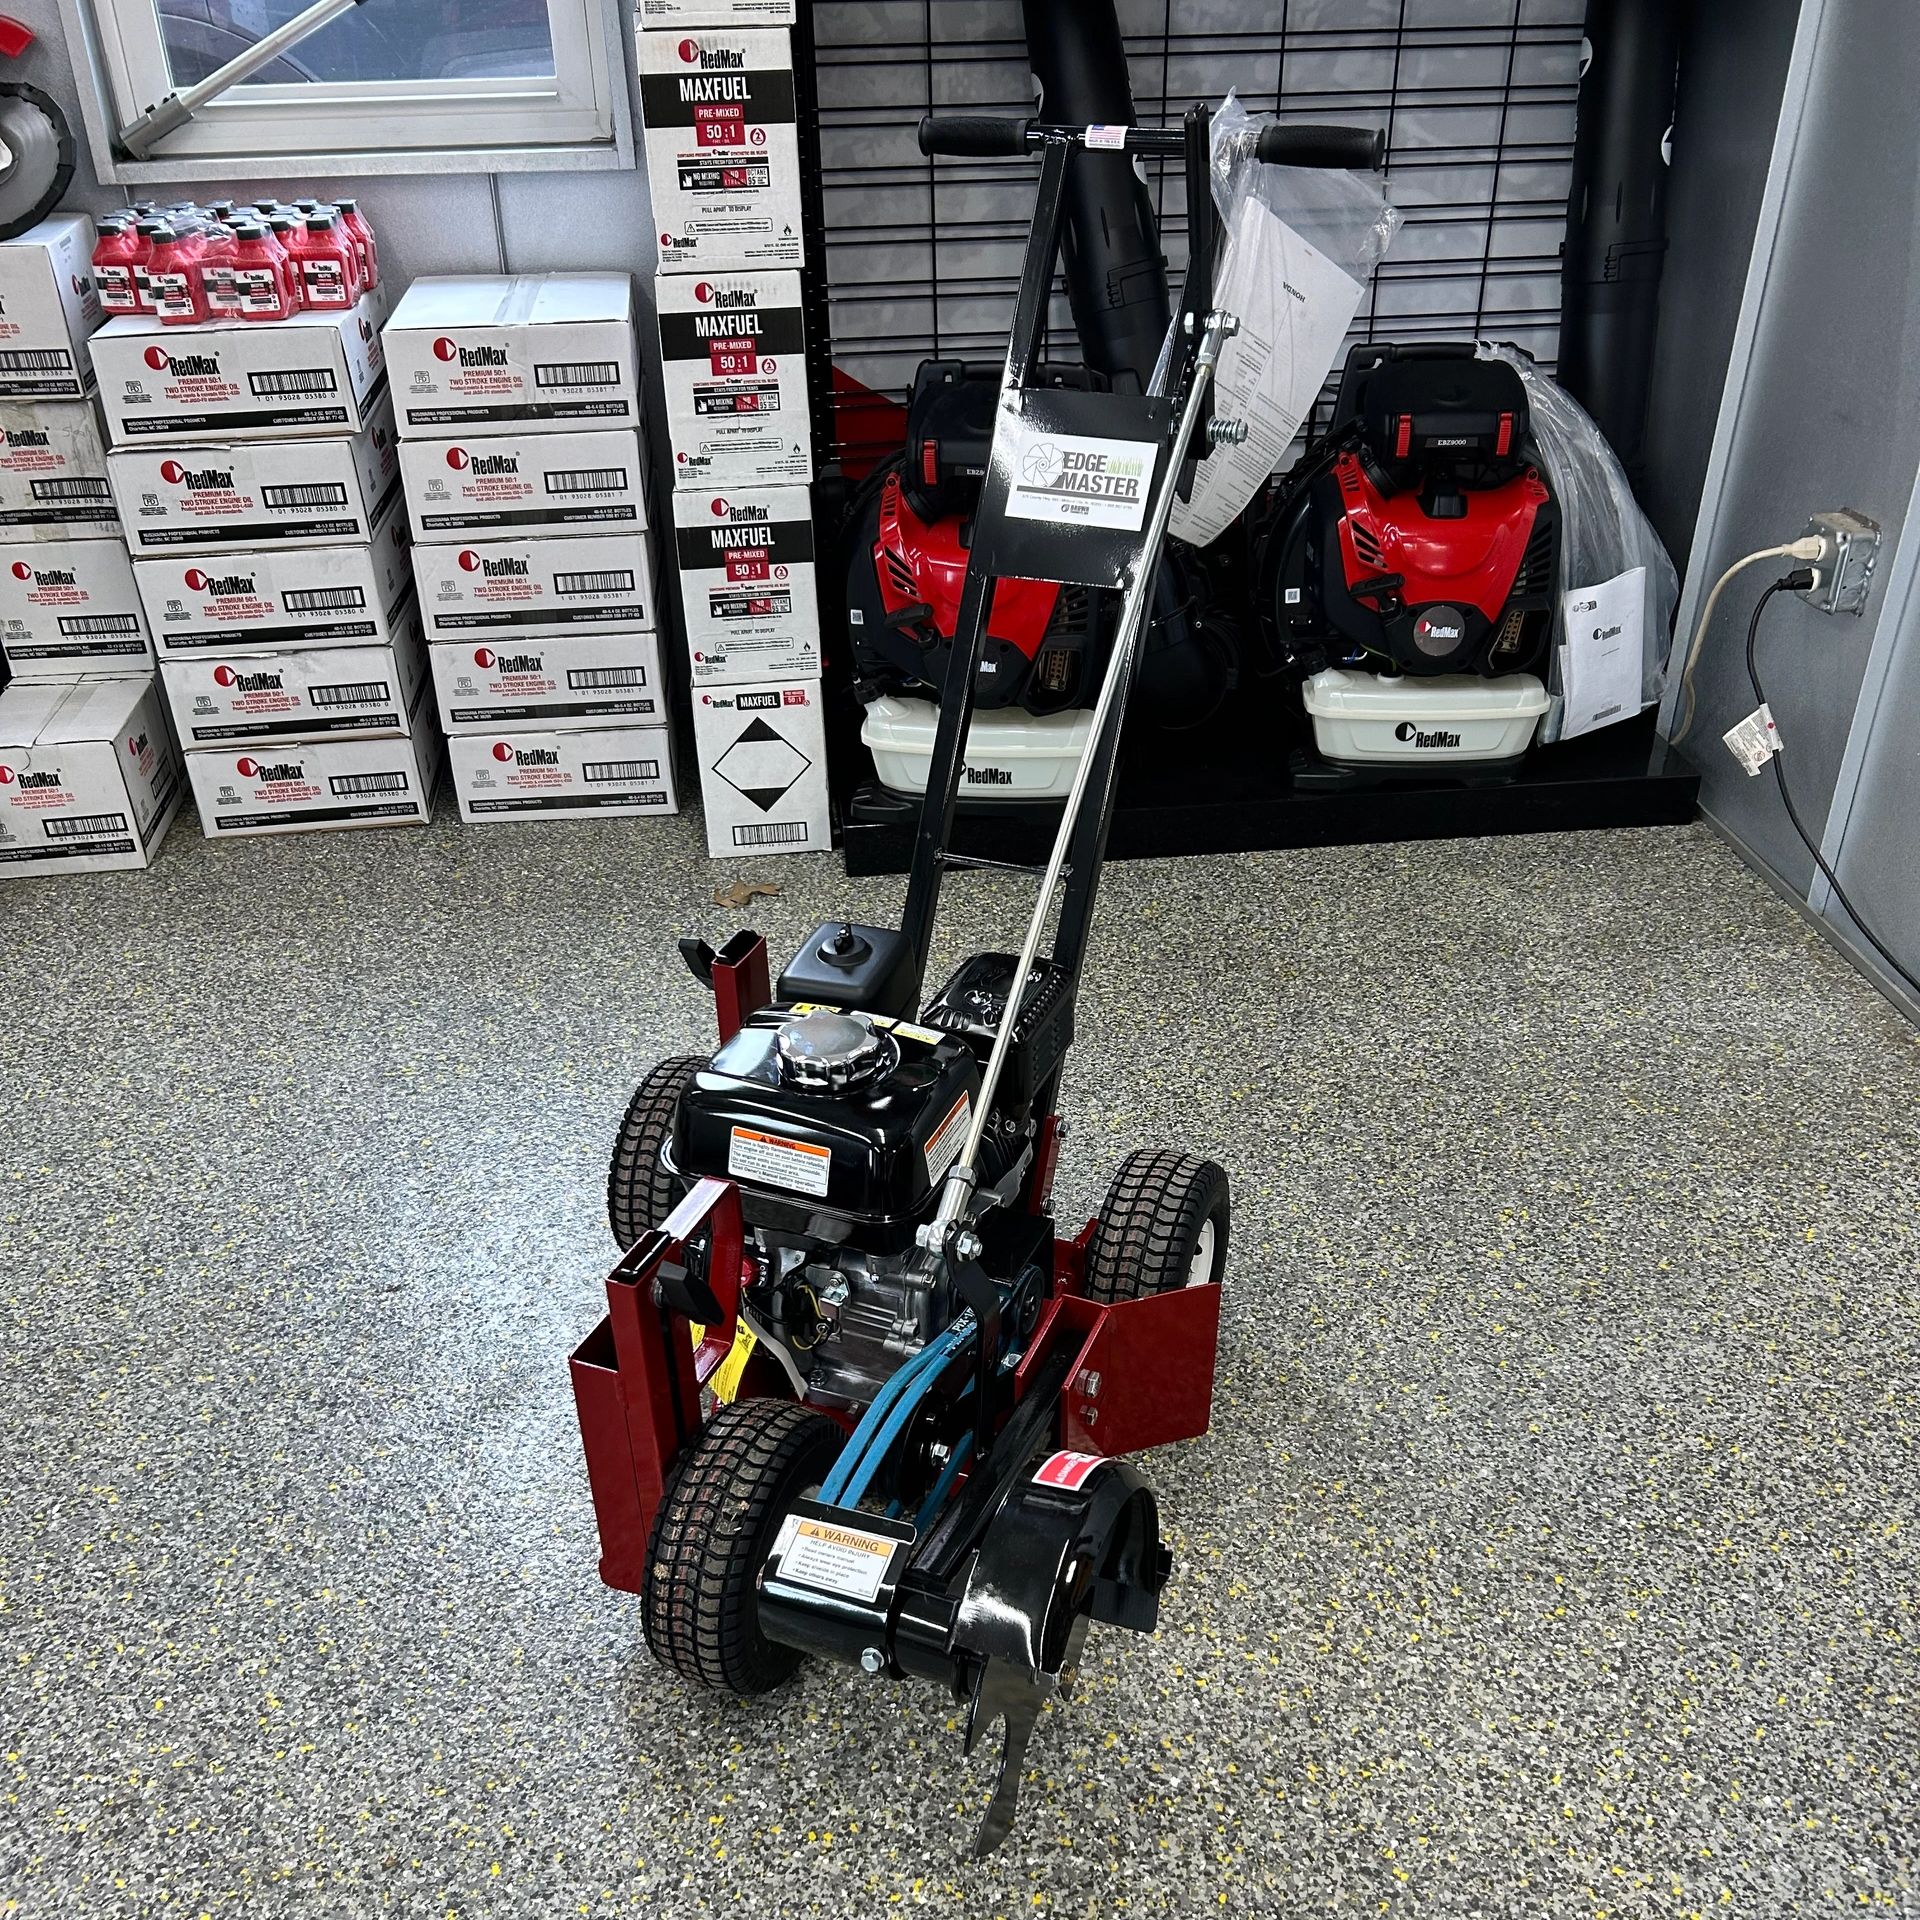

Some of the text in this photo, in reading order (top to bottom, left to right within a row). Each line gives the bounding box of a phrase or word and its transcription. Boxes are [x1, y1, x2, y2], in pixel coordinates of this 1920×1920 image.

[700, 49, 744, 69] RedMax
[679, 76, 751, 102] MAXFUEL
[699, 108, 740, 118] PRE-MIXED
[715, 290, 756, 308] RedMax
[1283, 281, 1306, 303] HONDA
[695, 314, 763, 337] MAXFUEL
[713, 341, 752, 350] PRE-MIXED
[168, 355, 220, 376] RedMax
[459, 346, 507, 367] RedMax
[6, 430, 50, 447] RedMax
[471, 455, 518, 475] RedMax
[1064, 451, 1108, 473] EDGE
[183, 469, 234, 490] RedMax
[1060, 472, 1140, 497] MASTER
[730, 506, 768, 522] RedMax
[711, 527, 775, 548] MAXFUEL
[729, 551, 765, 560] PRE-MIXED
[483, 558, 528, 577] RedMax
[34, 570, 76, 586] RedMax
[207, 575, 255, 595] RedMax
[215, 596, 244, 604] PREMIUM
[1431, 626, 1459, 638] RedMax
[498, 655, 542, 673] RedMax
[235, 672, 283, 691] RedMax
[740, 696, 777, 708] MAXFUEL
[1415, 731, 1461, 749] RedMax
[516, 749, 559, 766] RedMax
[18, 772, 62, 788] RedMax
[257, 763, 304, 781] RedMax
[967, 767, 1012, 785] RedMax
[769, 1137, 796, 1149] WARNING
[810, 1540, 870, 1559] HELP AVOID INJURY
[824, 1529, 879, 1552] WARNING
[795, 1568, 808, 1576] Keep
